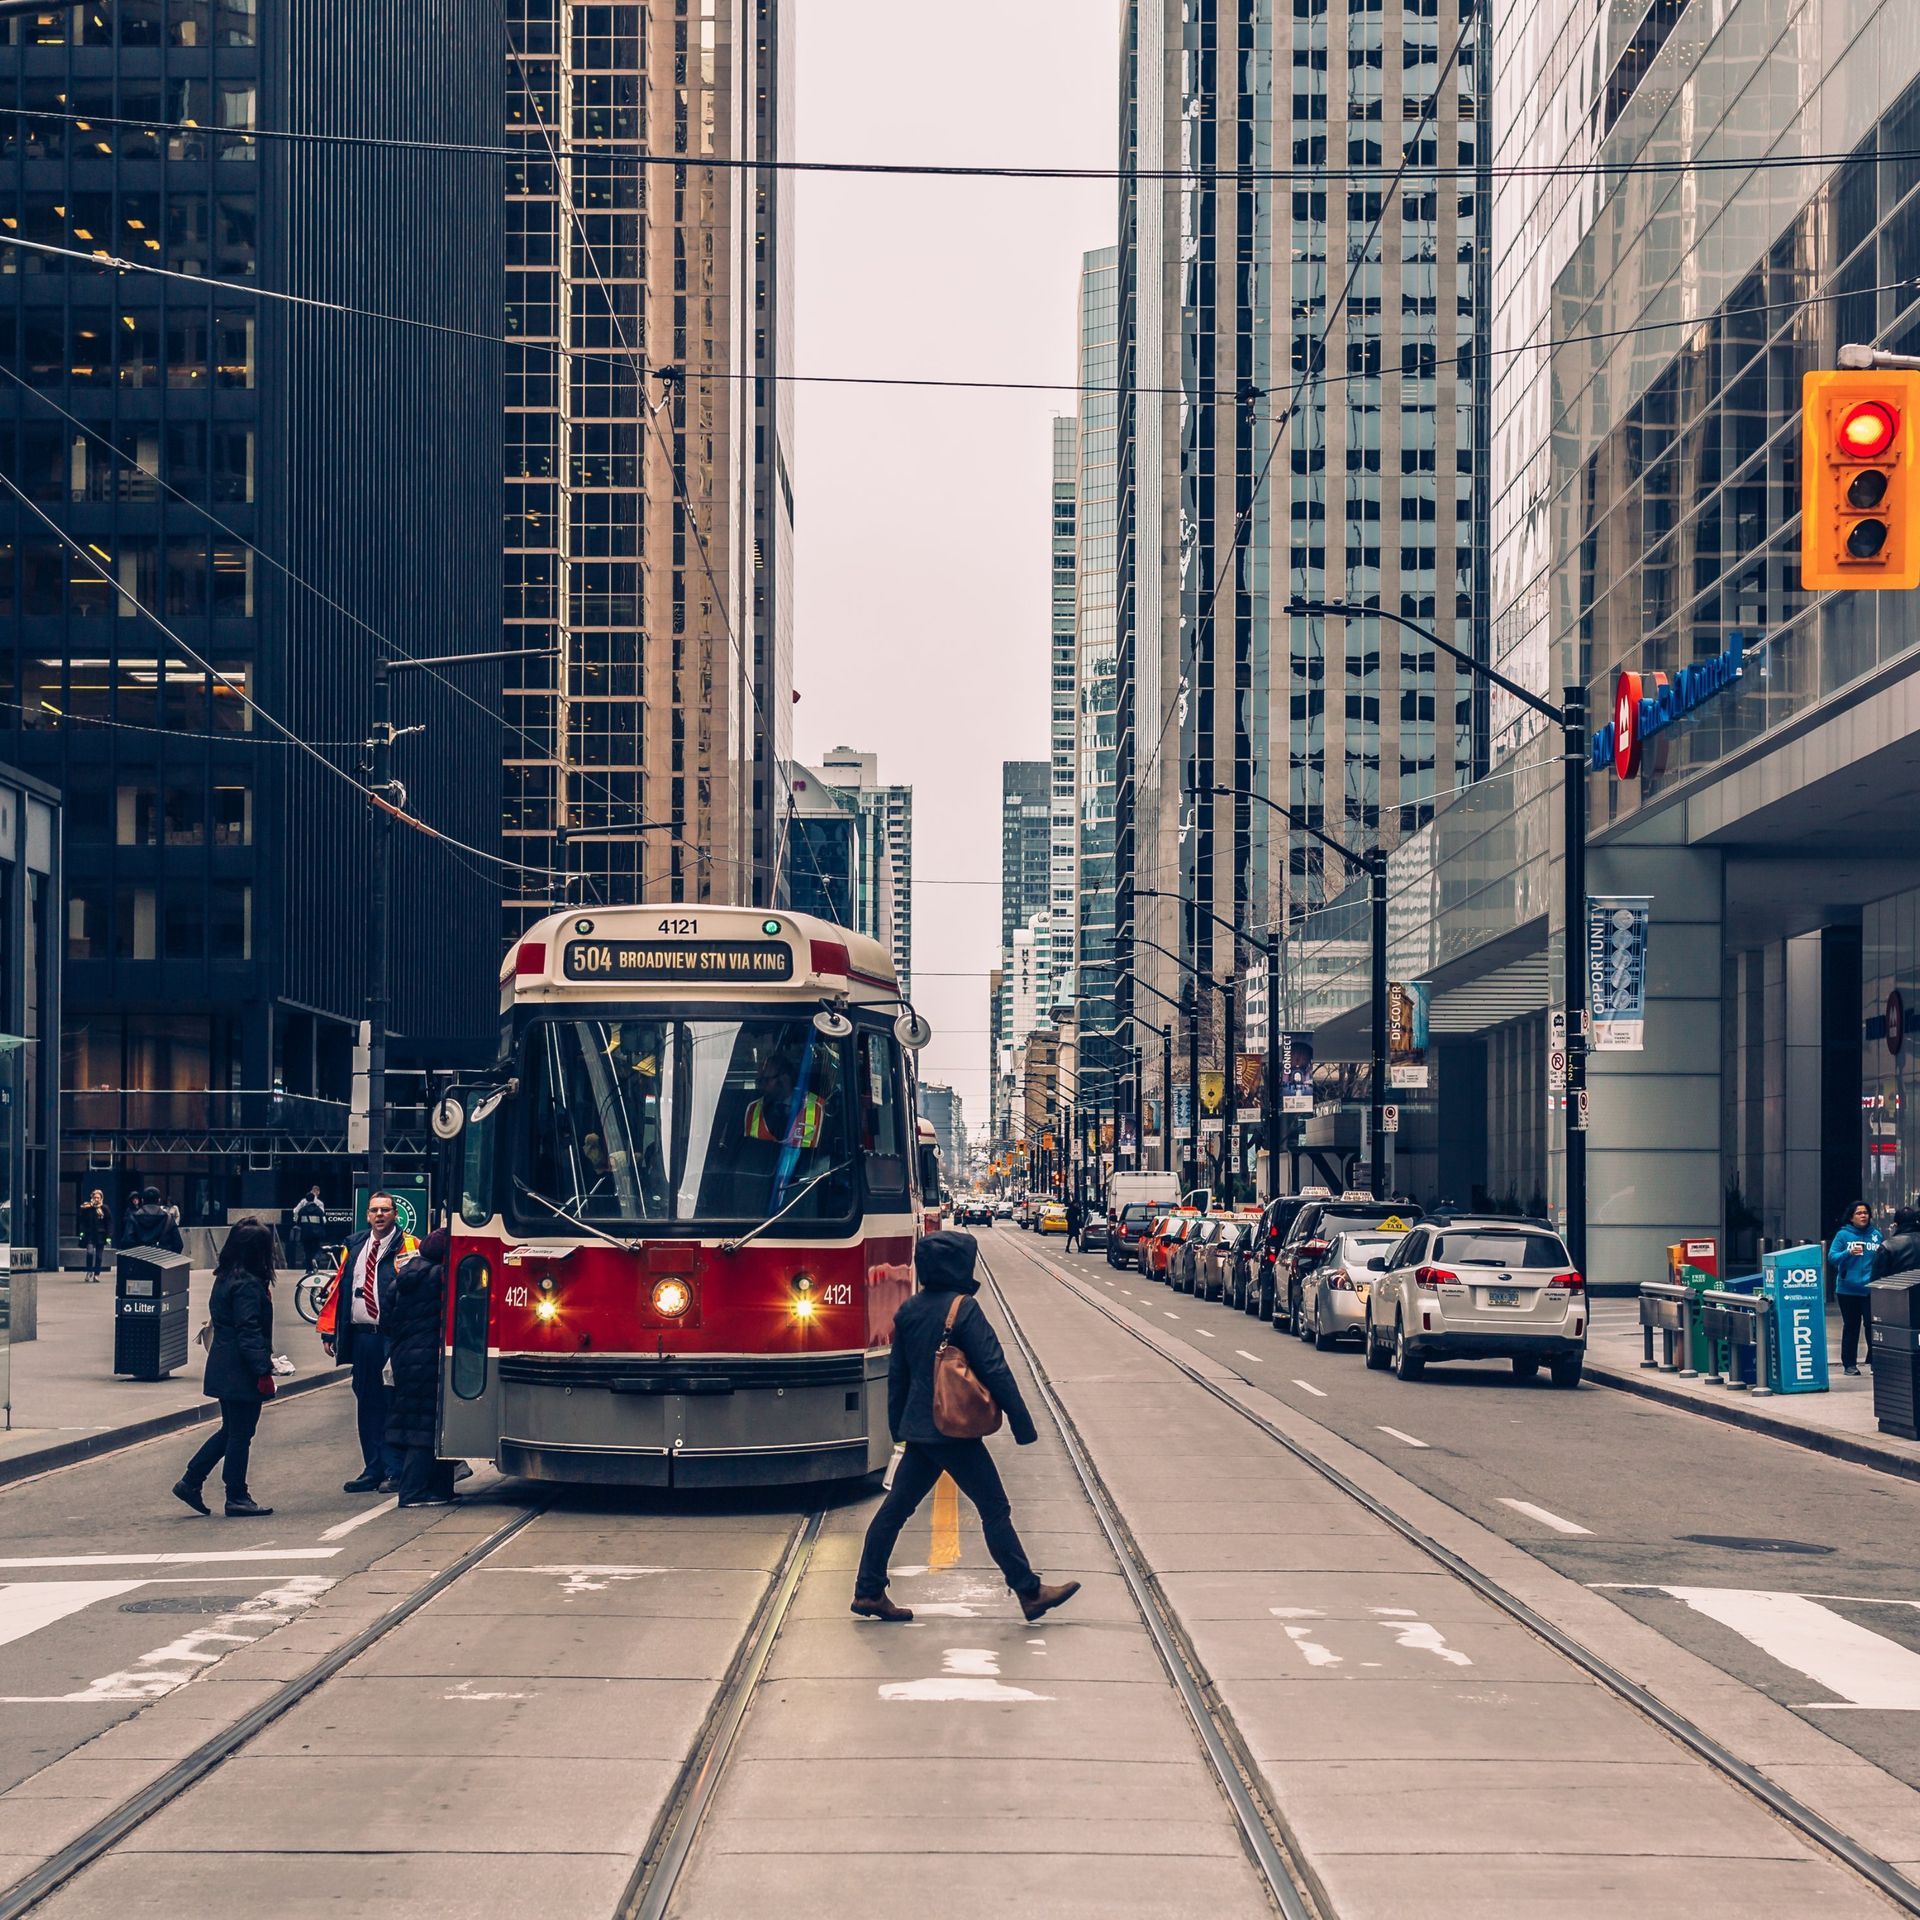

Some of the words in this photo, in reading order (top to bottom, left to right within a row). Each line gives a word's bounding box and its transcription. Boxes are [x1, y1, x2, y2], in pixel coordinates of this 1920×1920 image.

[658, 919, 698, 935] 4121
[573, 946, 612, 972] 504
[619, 952, 697, 969] BROADVIEW
[700, 953, 727, 970] STN
[729, 953, 751, 970] VIA
[753, 953, 786, 971] KING
[1590, 903, 1605, 1015] OPPORTUNITY
[1391, 986, 1402, 1040] DISCOVER
[1283, 1034, 1292, 1075] CONNECT
[20, 1252, 33, 1266] BANK
[1783, 1268, 1818, 1284] JOB
[505, 1286, 528, 1308] 4121
[823, 1284, 852, 1305] 4121
[134, 1303, 156, 1313] Litter
[1792, 1308, 1814, 1380] FREE
